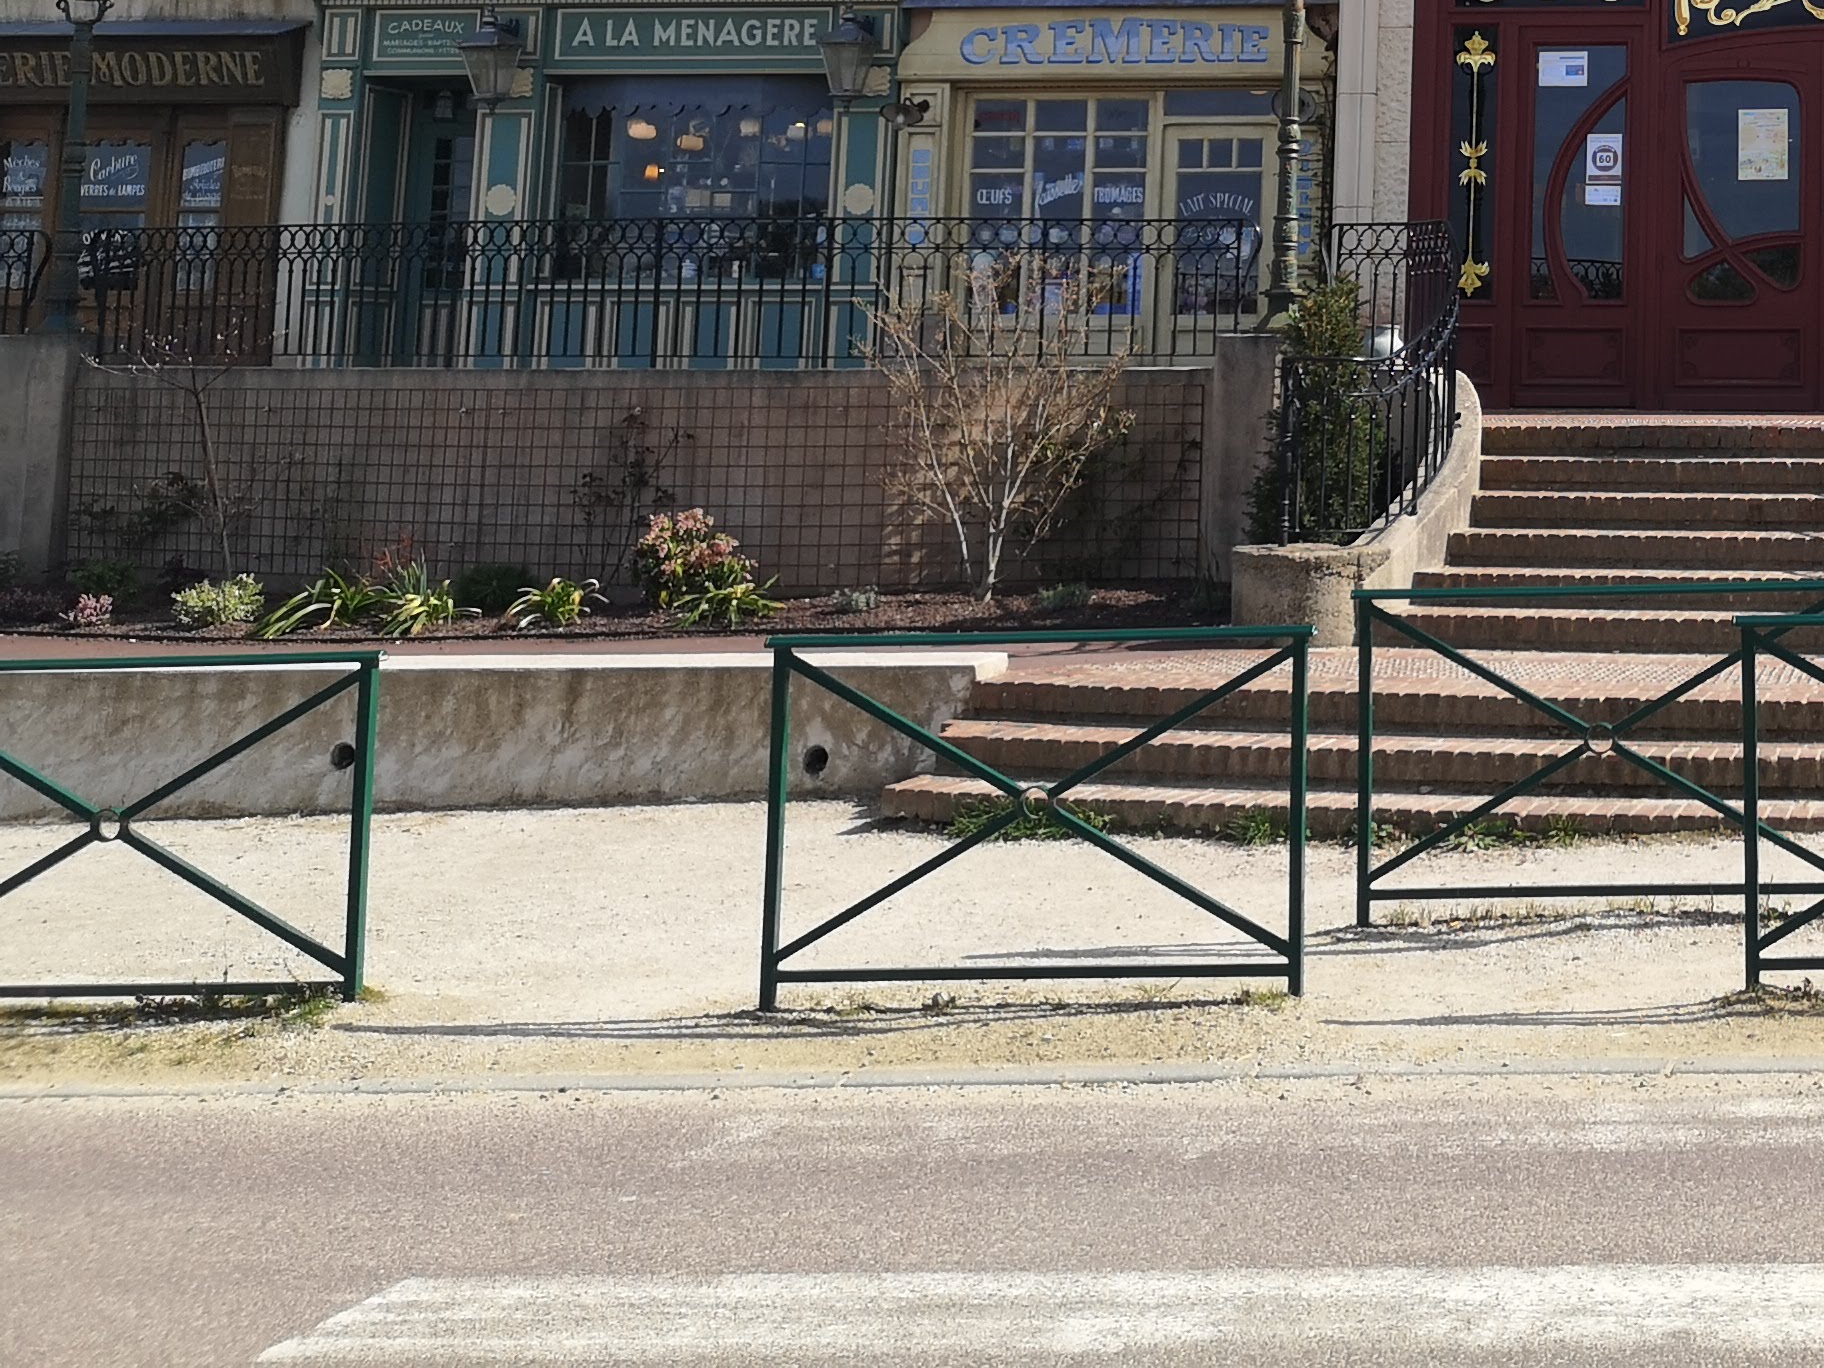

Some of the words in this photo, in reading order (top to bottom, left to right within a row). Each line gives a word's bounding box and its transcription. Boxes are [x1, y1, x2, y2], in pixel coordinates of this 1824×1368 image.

[388, 18, 464, 34] CADEAUX
[572, 17, 595, 47] A
[605, 17, 640, 47] LA
[653, 17, 819, 48] MENAGERE
[960, 16, 1269, 65] CREMERIE
[91, 51, 265, 87] MODERNE
[90, 154, 138, 181] Carbure
[1599, 154, 1612, 164] 60
[118, 185, 145, 197] LAMPES
[1094, 186, 1144, 203] FROMAGES
[1179, 193, 1205, 216] LAIT
[1208, 192, 1254, 216] SPECIAL
